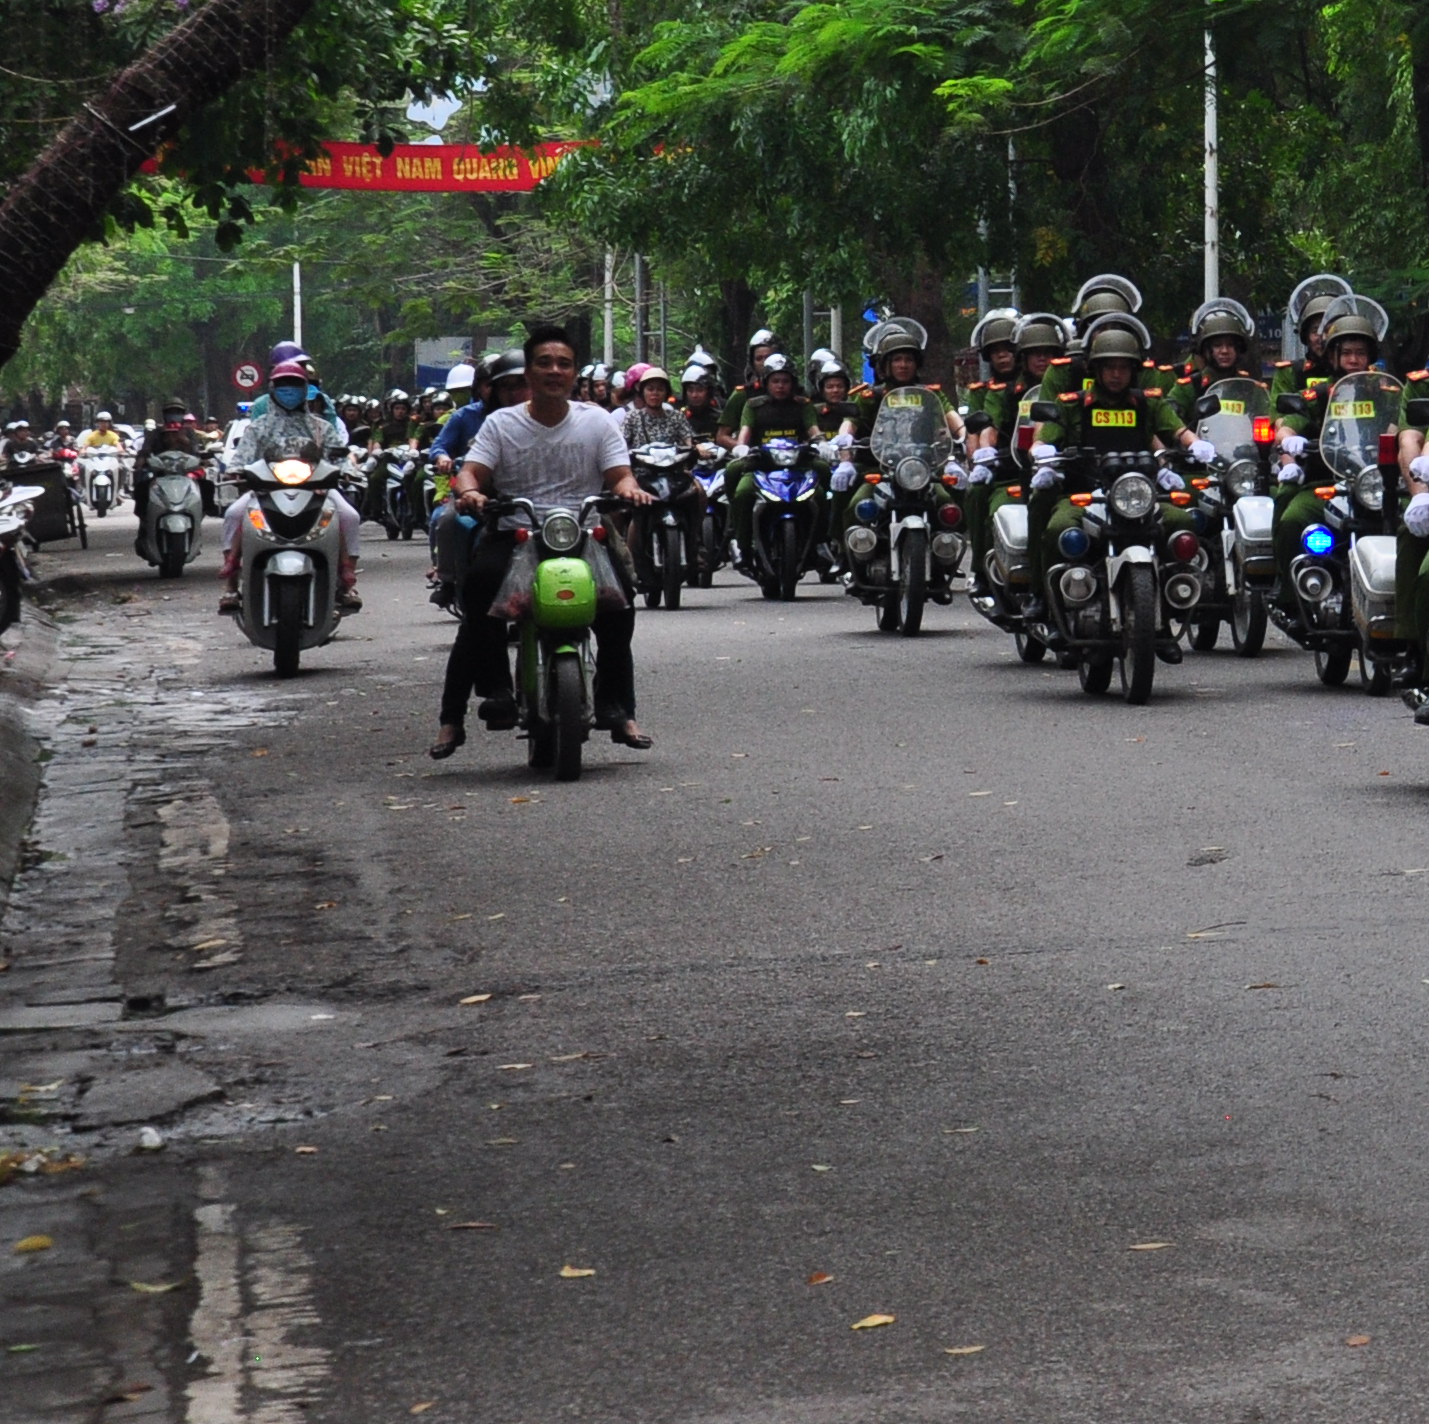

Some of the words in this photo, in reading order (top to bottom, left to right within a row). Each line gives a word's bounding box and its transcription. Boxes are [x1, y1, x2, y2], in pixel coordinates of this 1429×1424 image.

[396, 156, 443, 180] NAM
[1352, 403, 1372, 415] 113
[1095, 411, 1110, 424] CS
[1114, 411, 1133, 425] 113
